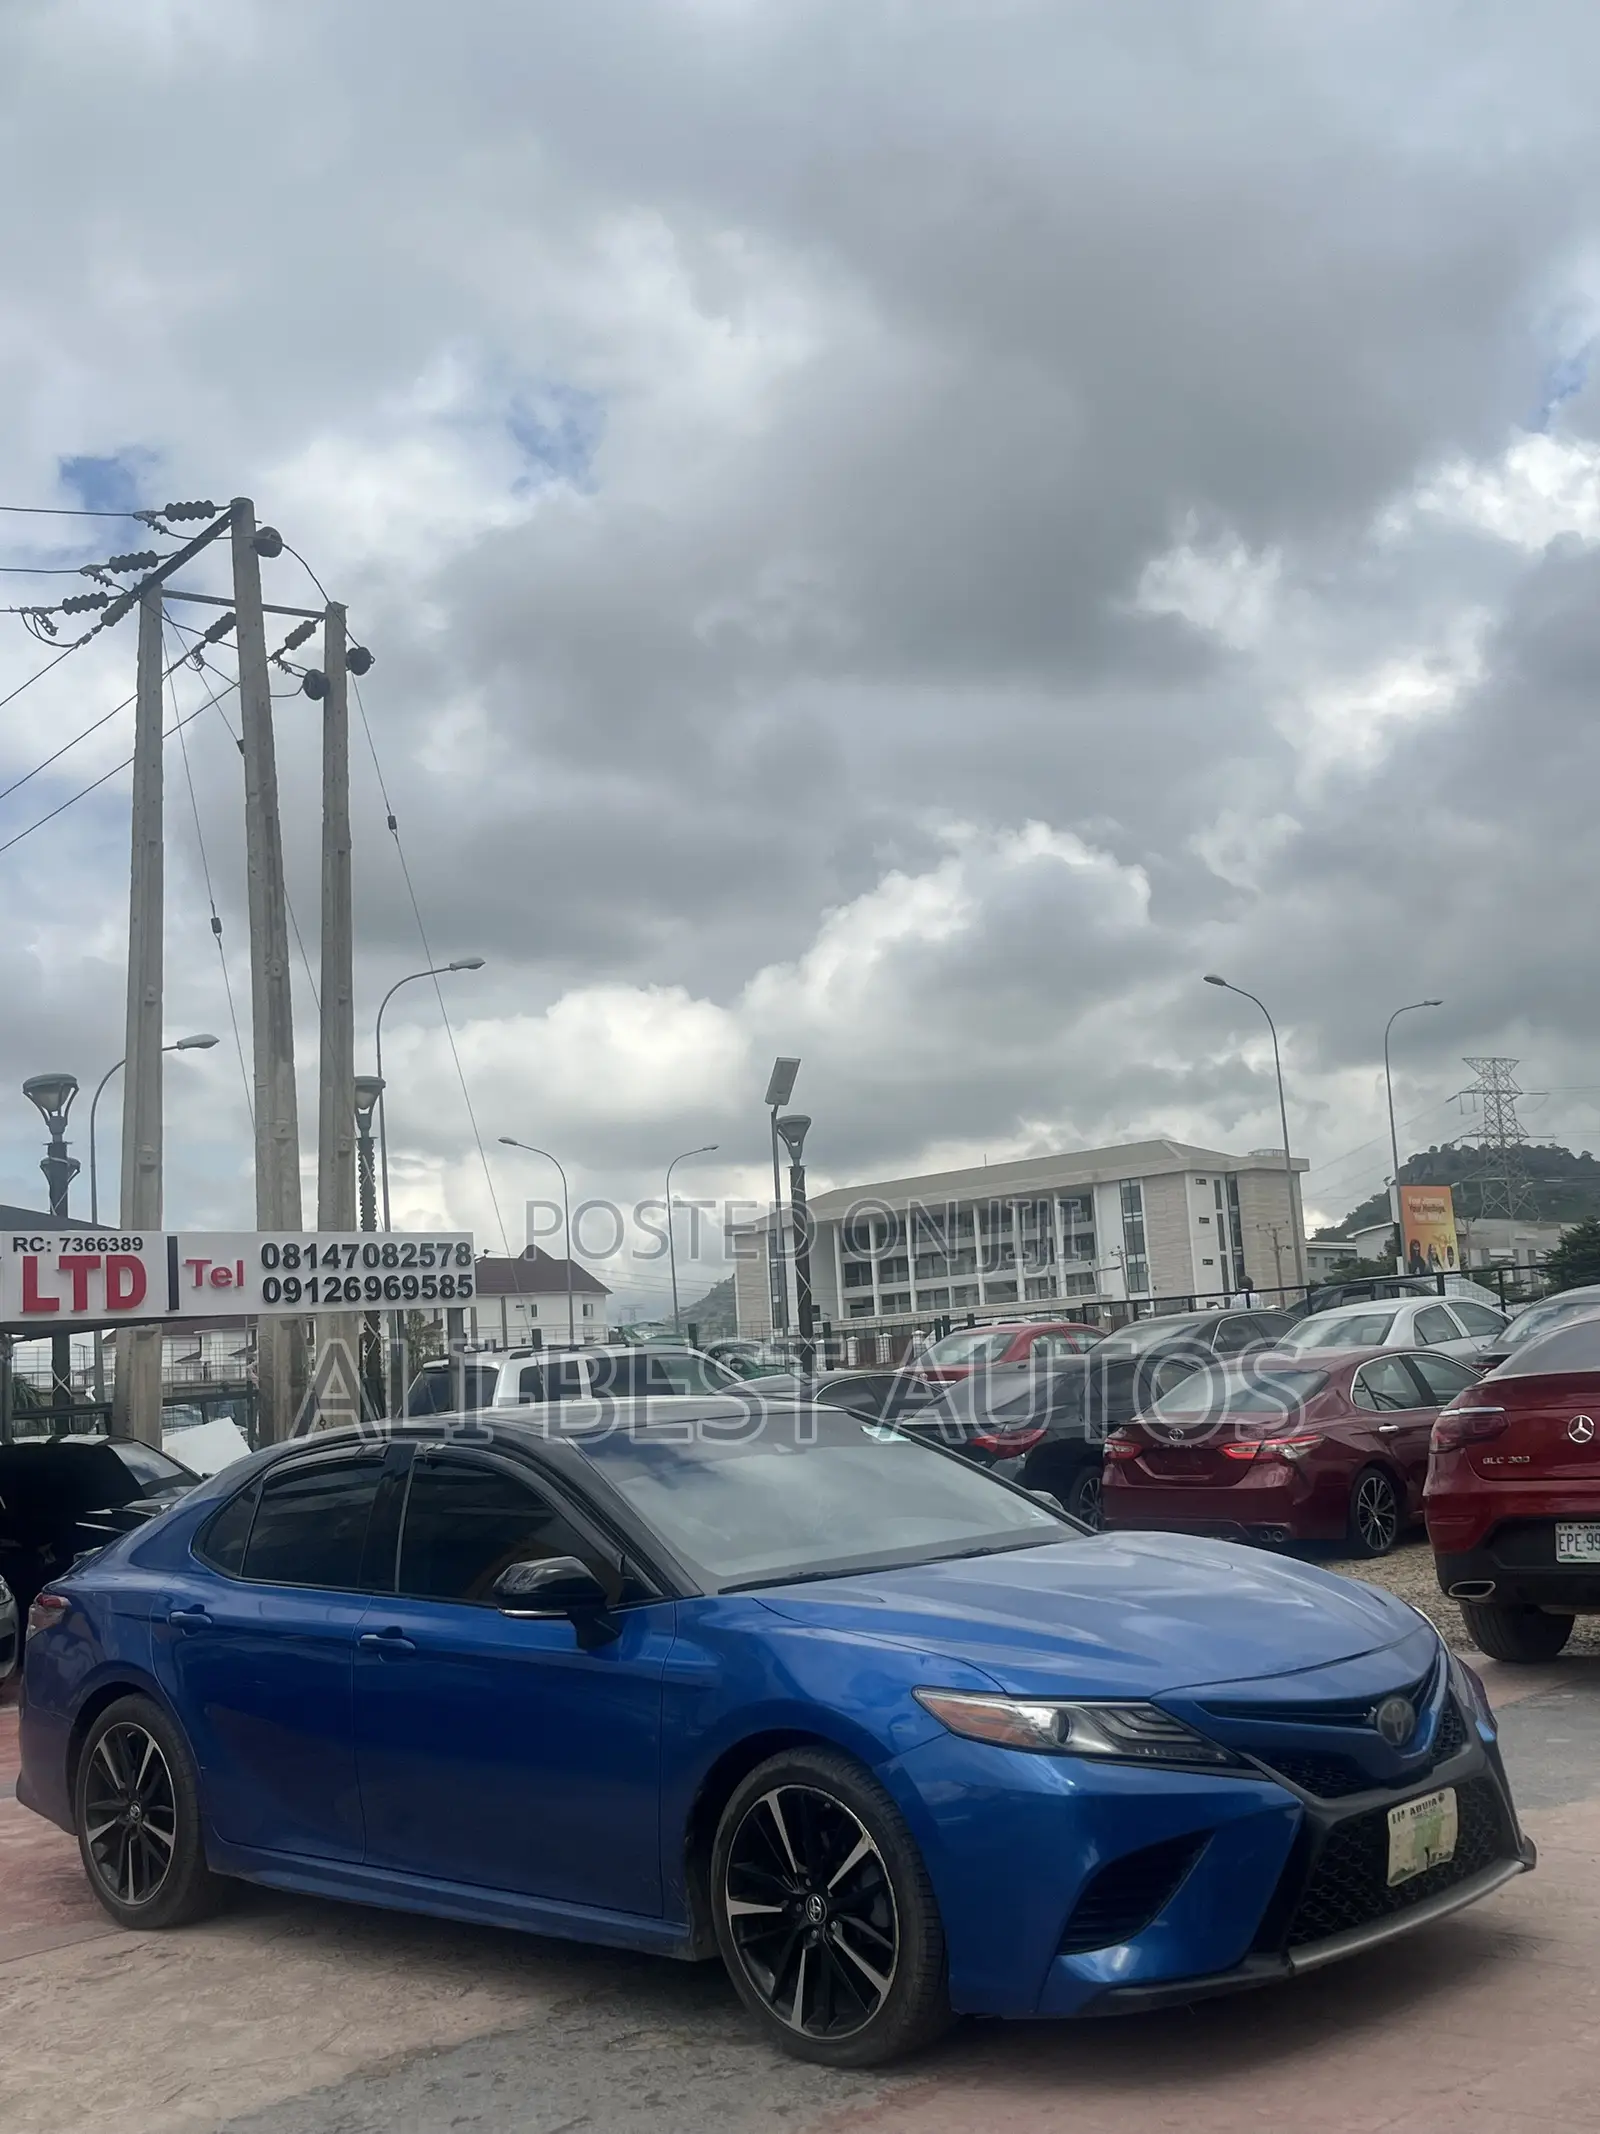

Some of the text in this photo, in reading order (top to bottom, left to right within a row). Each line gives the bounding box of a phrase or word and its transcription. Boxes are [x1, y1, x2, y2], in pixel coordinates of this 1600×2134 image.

[12, 1236, 144, 1253] RC: 7366389
[260, 1241, 472, 1270] 08147082578
[20, 1254, 148, 1313] LTD
[184, 1258, 245, 1288] Tel
[262, 1273, 474, 1304] 09126969585
[1482, 1456, 1505, 1464] GLC
